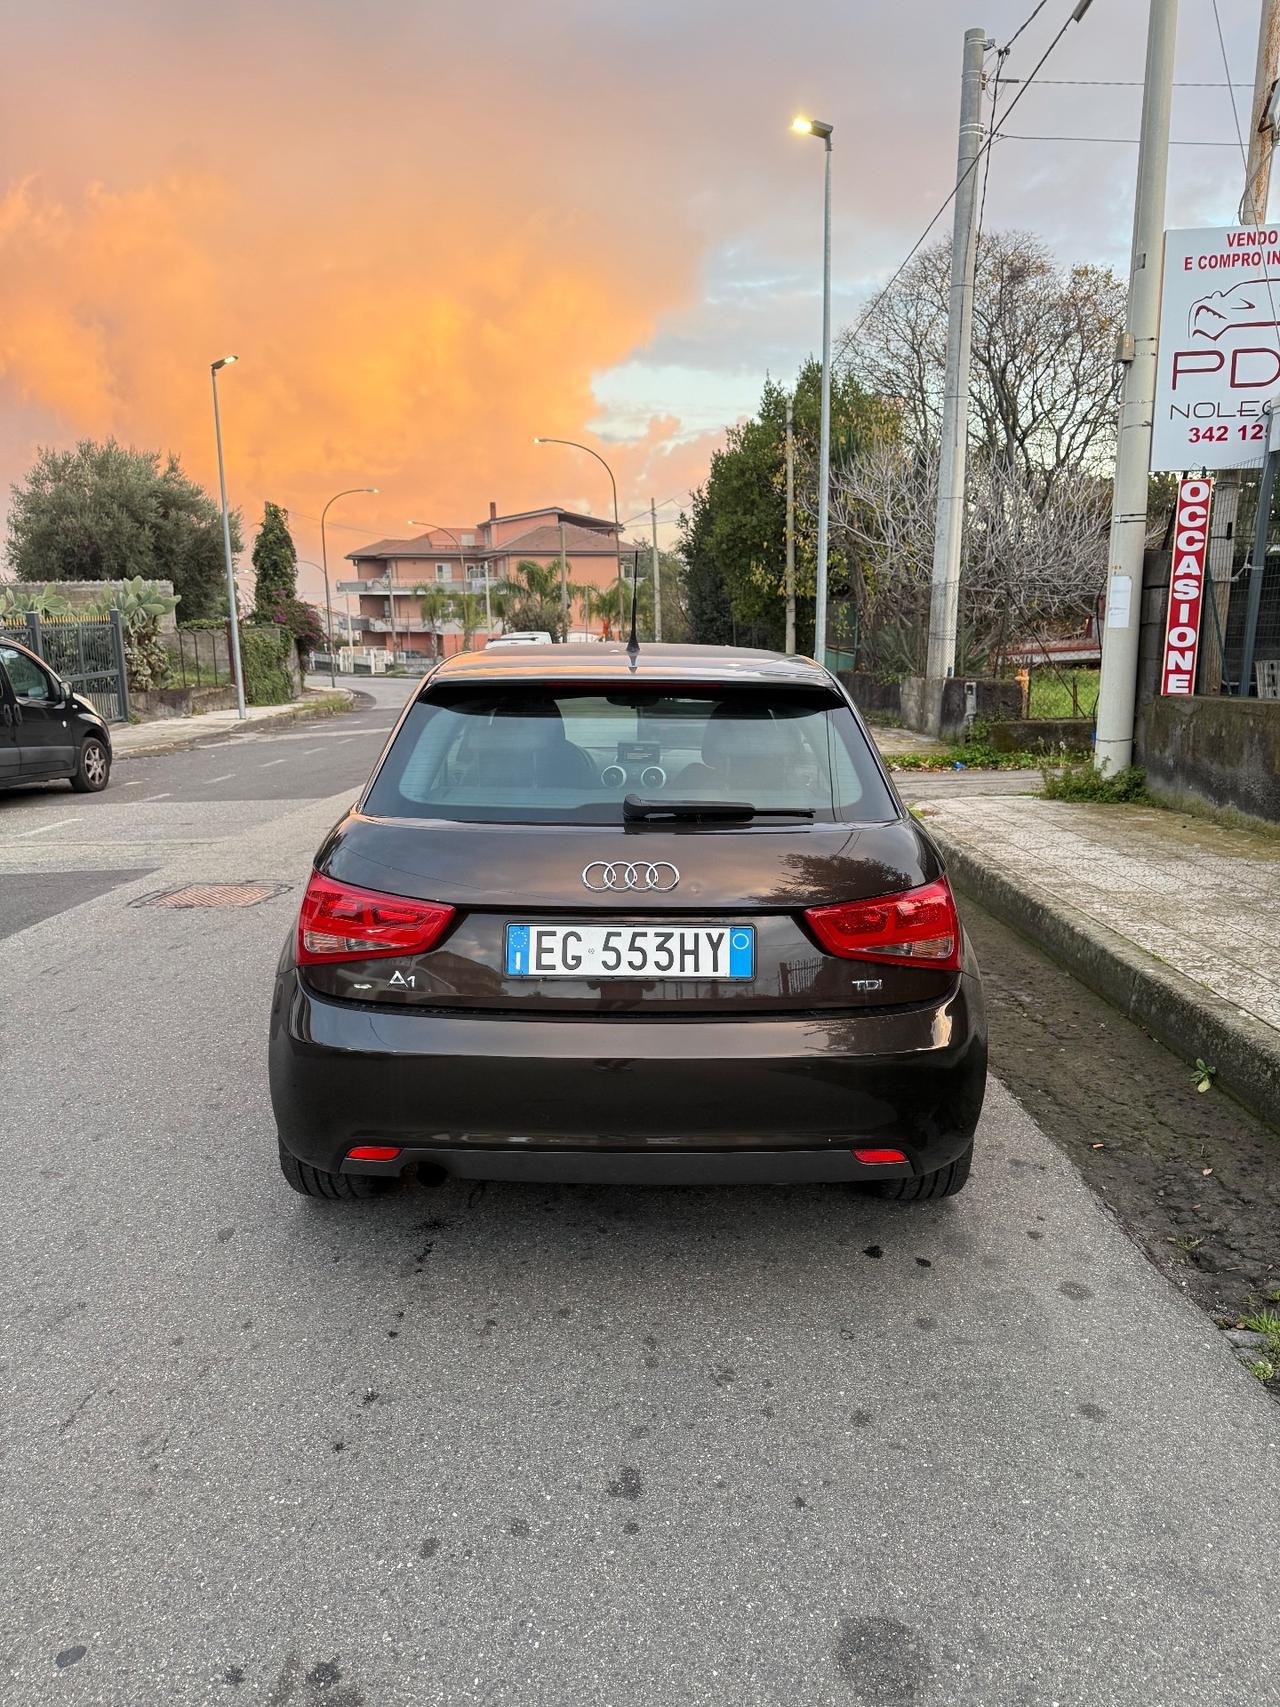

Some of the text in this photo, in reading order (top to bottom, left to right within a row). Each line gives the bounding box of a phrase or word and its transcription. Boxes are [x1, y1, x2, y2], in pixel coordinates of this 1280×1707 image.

[1226, 230, 1278, 247] VENDO
[1184, 256, 1193, 271] E
[1198, 251, 1262, 269] COMPRO
[1188, 423, 1269, 443] 342 12
[1167, 481, 1210, 694] OCCASIONE
[515, 951, 521, 970] I
[535, 930, 725, 973] EG 553HY
[386, 970, 416, 988] A1
[852, 979, 882, 991] TDI
